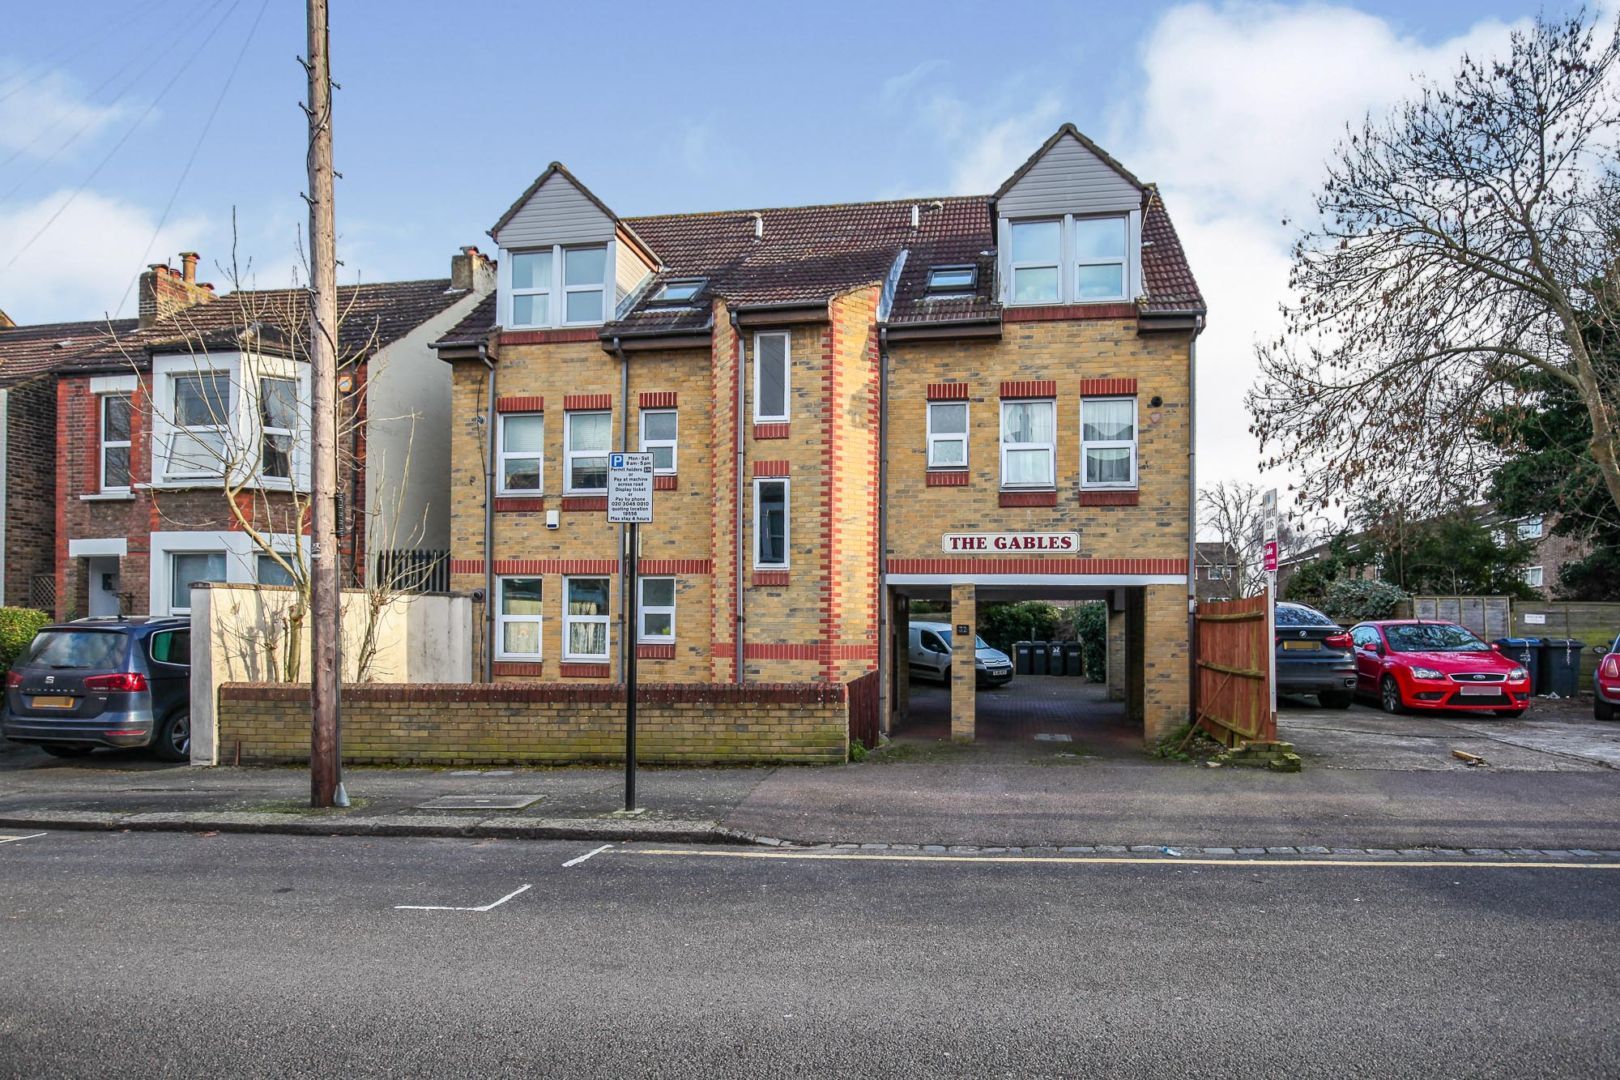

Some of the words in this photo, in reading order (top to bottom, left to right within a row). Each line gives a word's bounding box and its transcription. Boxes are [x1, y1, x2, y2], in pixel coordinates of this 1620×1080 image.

[614, 456, 622, 467] P
[950, 537, 987, 549] THE
[994, 536, 1072, 549] GABLES
